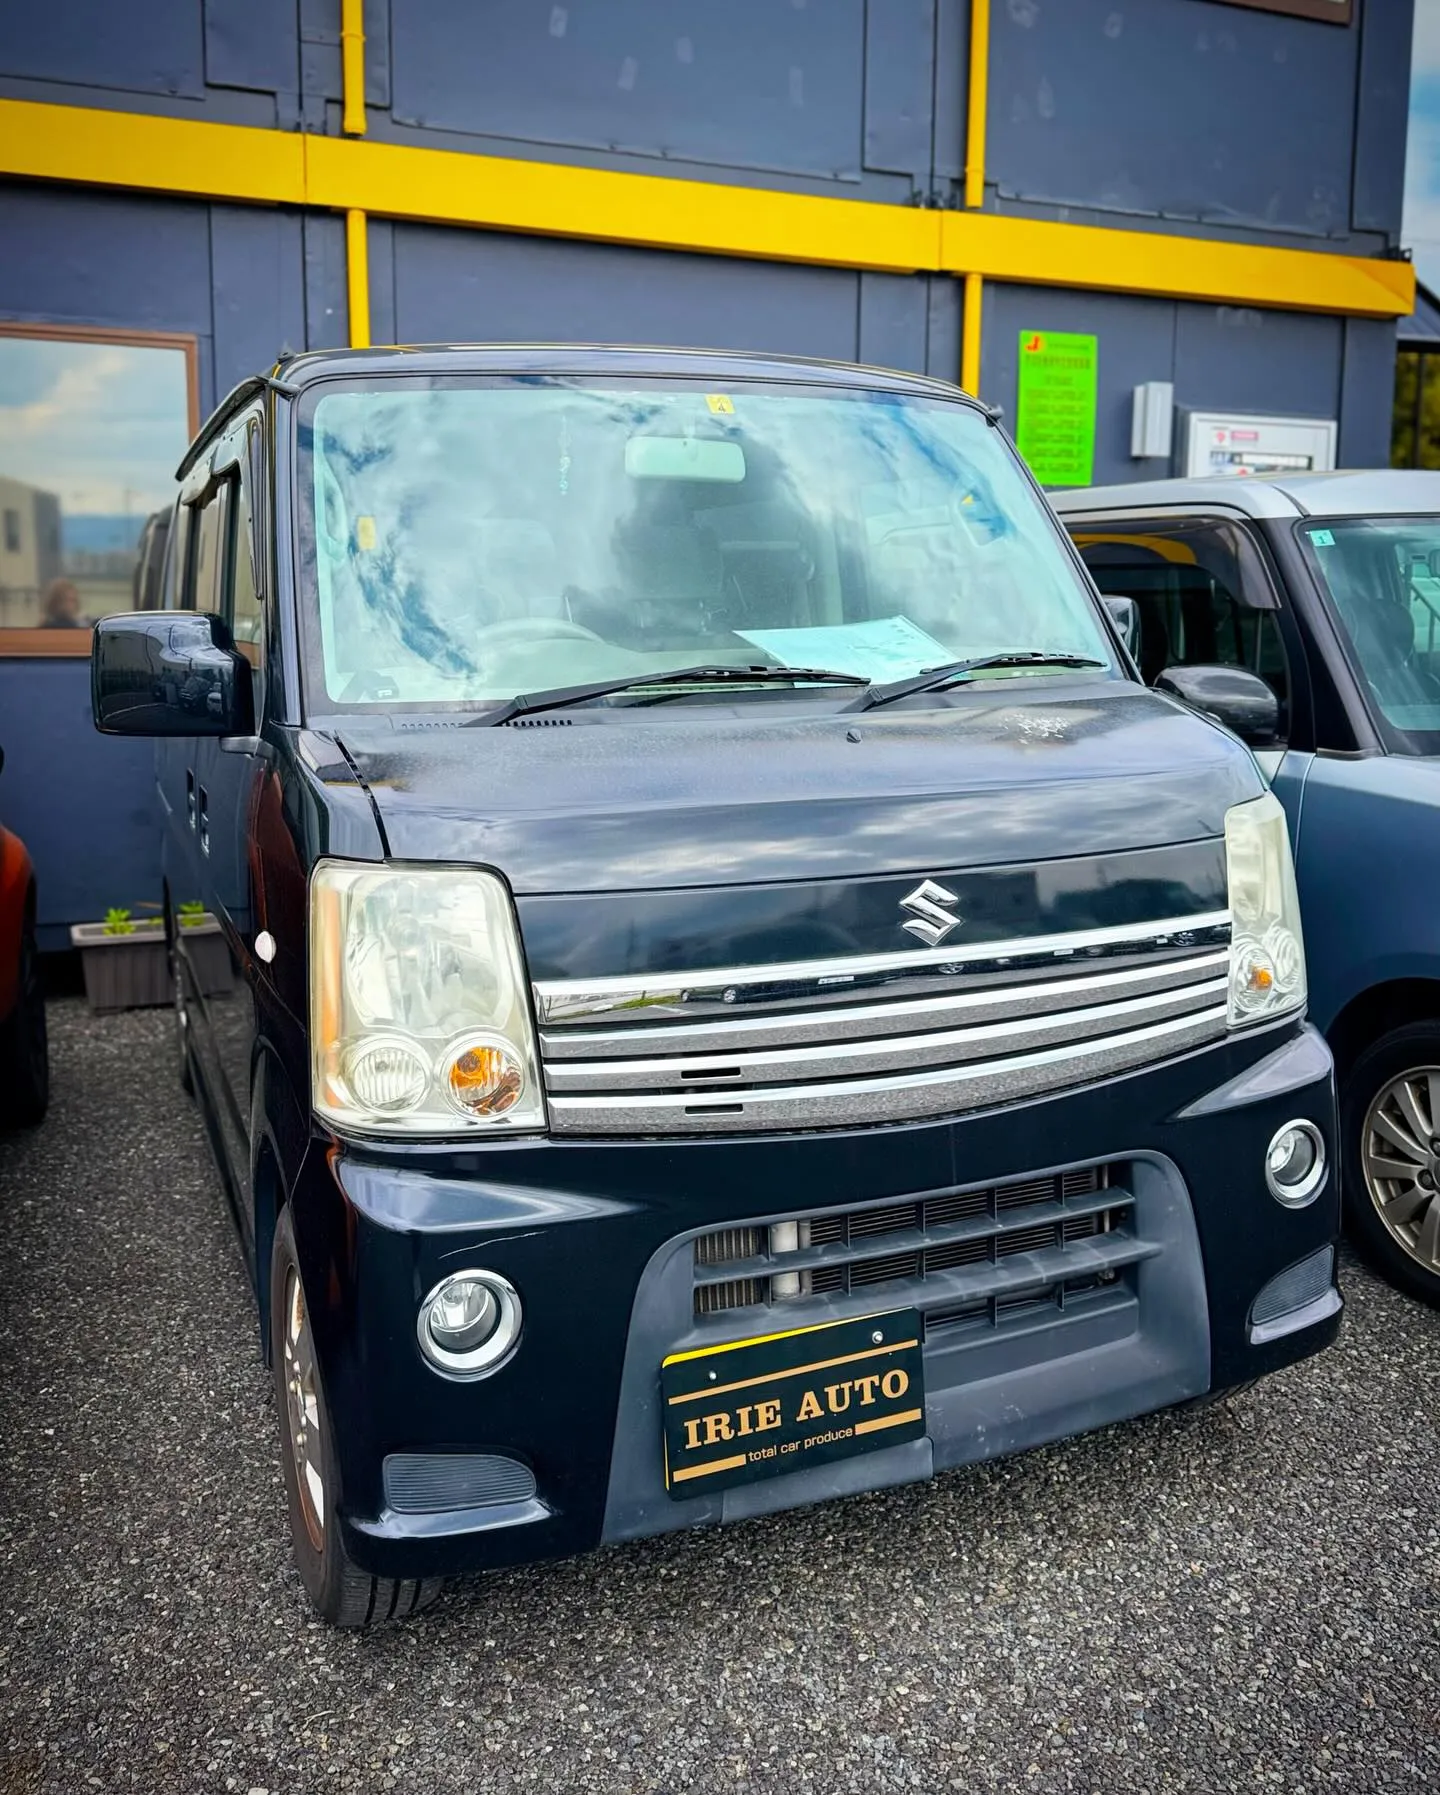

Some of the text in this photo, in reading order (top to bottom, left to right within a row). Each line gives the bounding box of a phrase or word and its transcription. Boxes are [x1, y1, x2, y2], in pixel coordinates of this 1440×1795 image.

[683, 1369, 910, 1449] IRIE AUTO
[748, 1427, 854, 1462] total car produce
